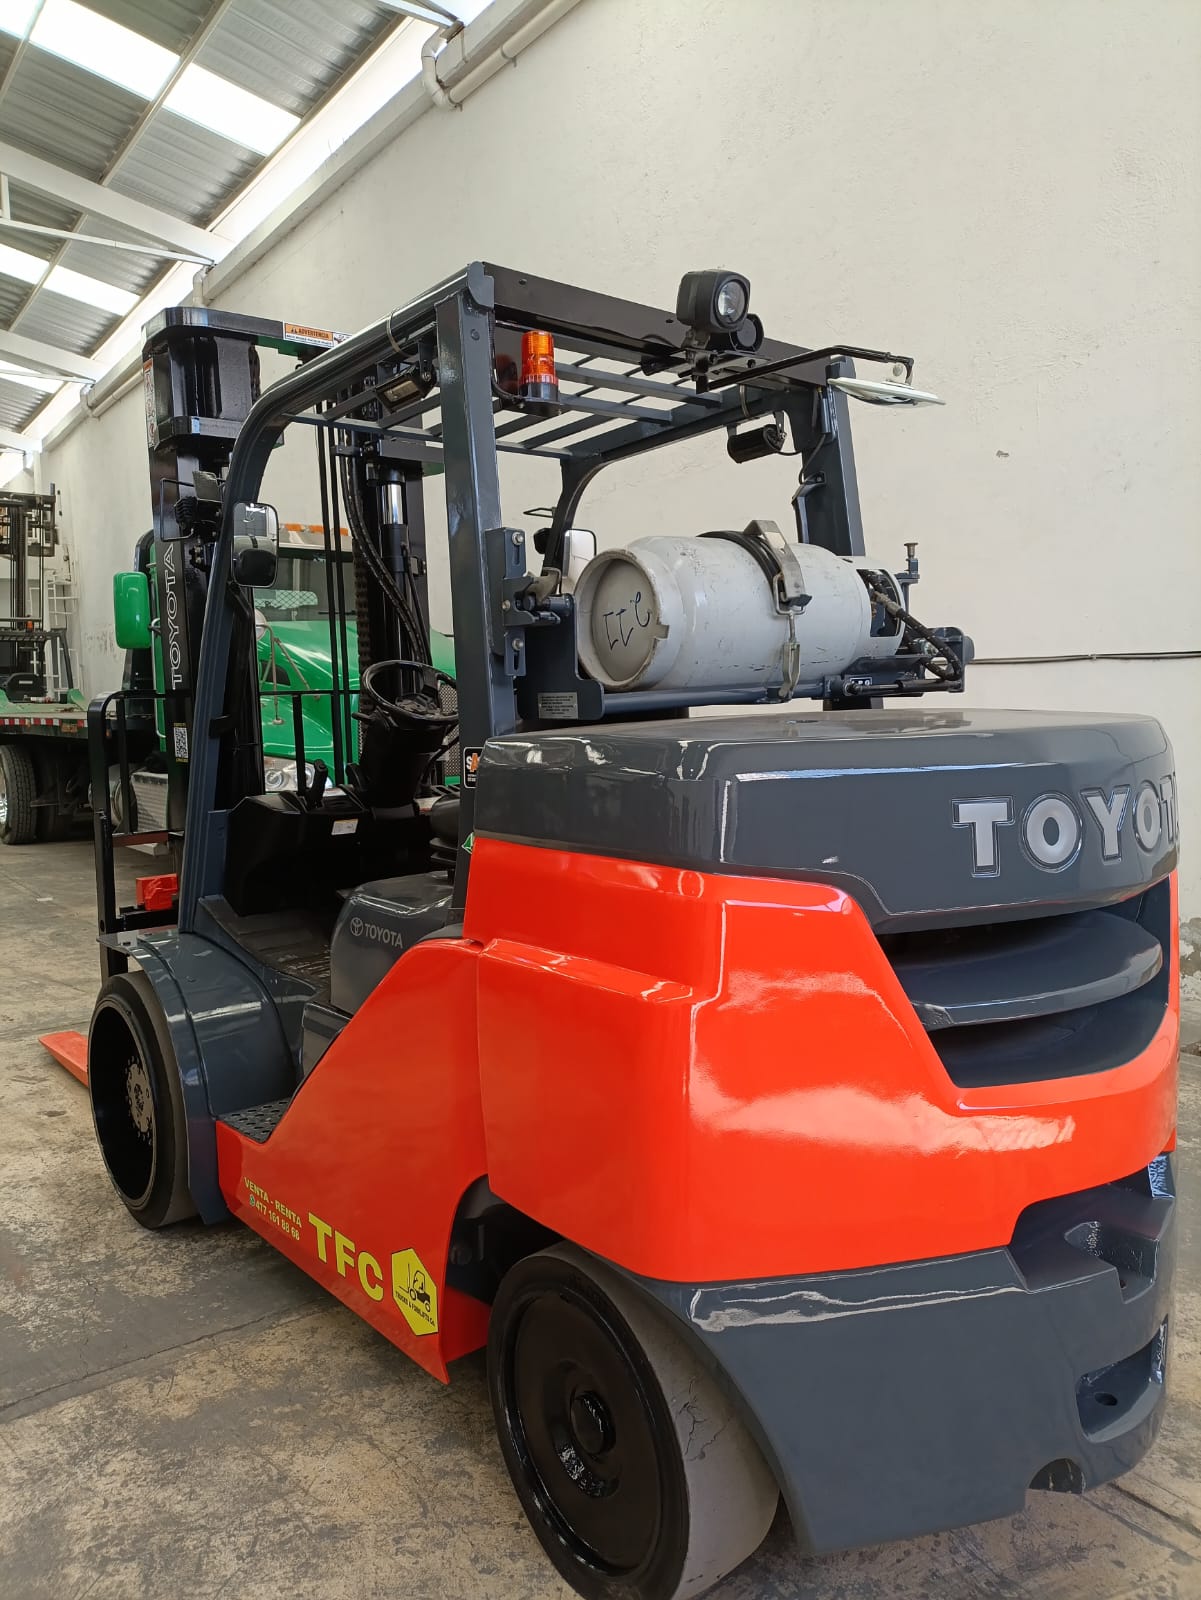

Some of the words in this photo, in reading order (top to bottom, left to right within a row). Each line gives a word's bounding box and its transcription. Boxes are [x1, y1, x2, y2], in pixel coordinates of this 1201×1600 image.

[164, 543, 183, 690] TOYOTA
[364, 923, 403, 949] TOYOTA
[244, 1176, 269, 1203] VENTA
[275, 1199, 302, 1228] RENTA
[256, 1200, 267, 1215] 477
[308, 1211, 384, 1302] TFC
